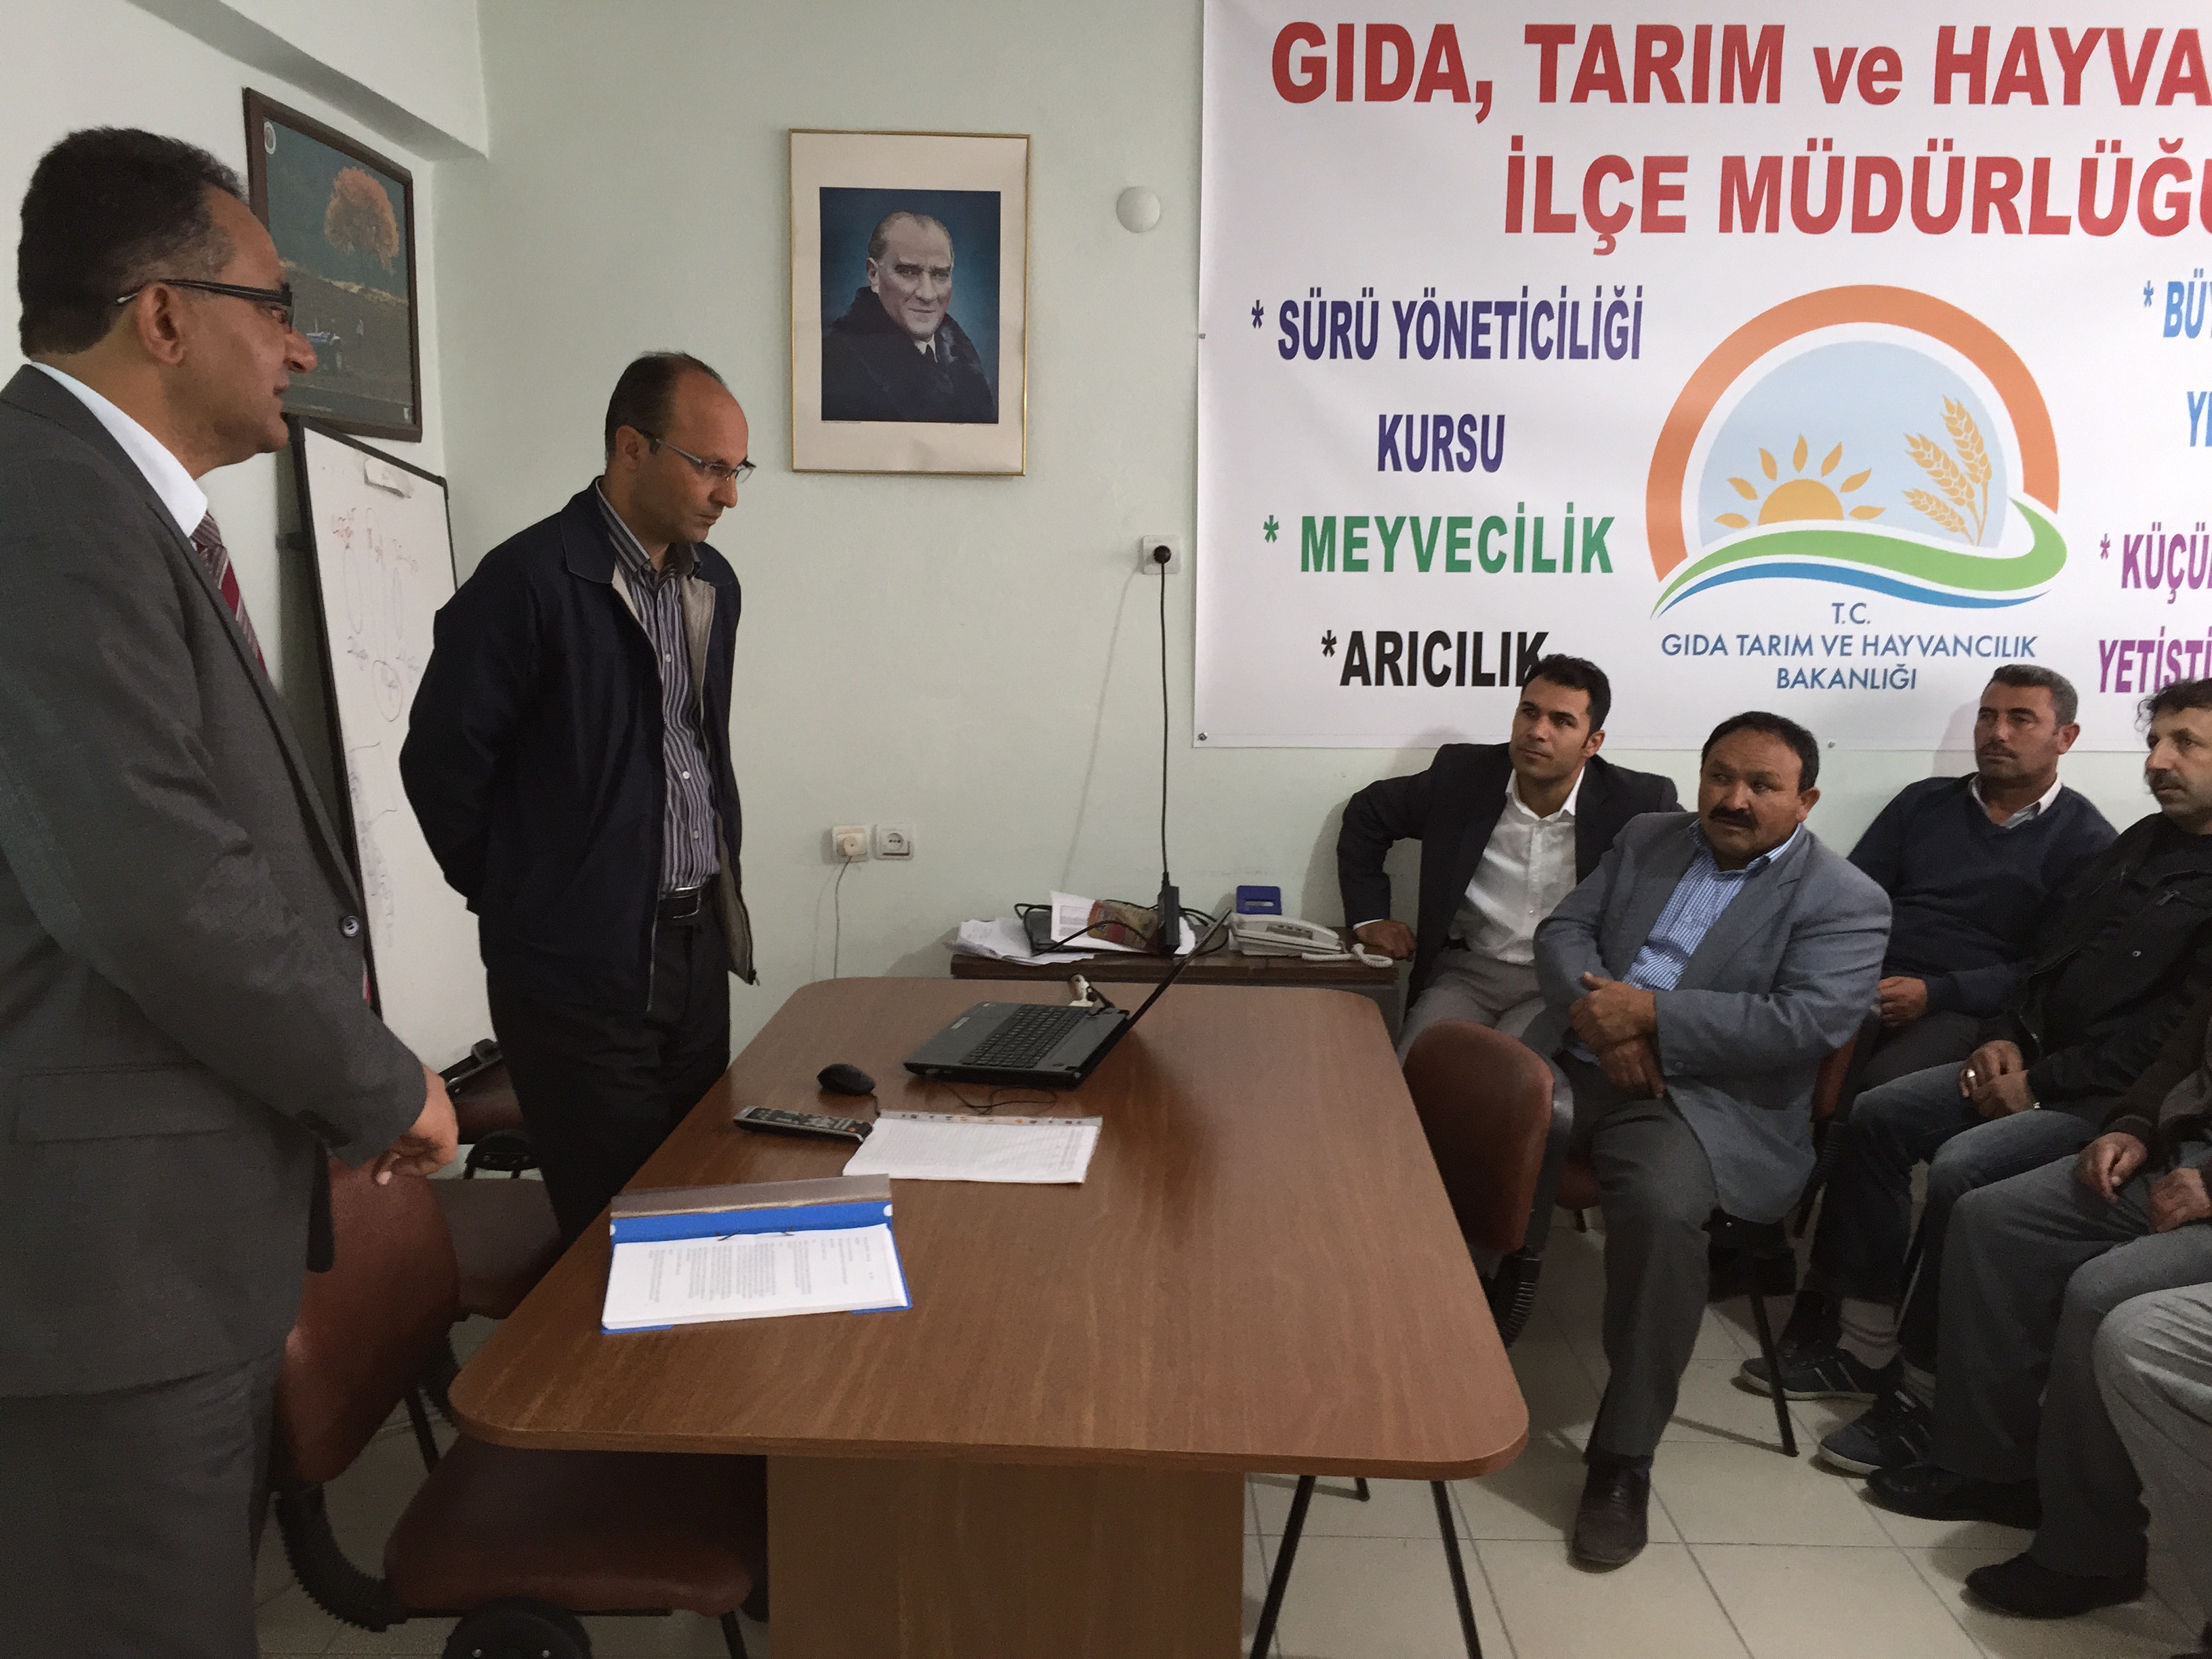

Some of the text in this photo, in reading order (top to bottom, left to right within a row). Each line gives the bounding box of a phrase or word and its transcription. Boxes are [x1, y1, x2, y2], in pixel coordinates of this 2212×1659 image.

[1272, 22, 1492, 124] GIDA,
[1524, 24, 1785, 104] TARIM
[1813, 46, 1902, 106] ve
[1505, 135, 2212, 255] İLÇE MÜDÜRLÜĞ
[1278, 285, 1642, 361] SÜRÜ YÖNETİCİLİĞİ
[1378, 413, 1505, 472] KURSU
[1300, 501, 1615, 573] MEYVECİLİK
[2121, 522, 2212, 605] KÜÇÜ
[1831, 602, 1871, 624] T.C.
[1339, 630, 1549, 687] ARICILIK
[1662, 634, 2038, 659] GIDA TARIM VE HAYVANCILIK
[1776, 663, 1917, 691] BAKANLIĞI
